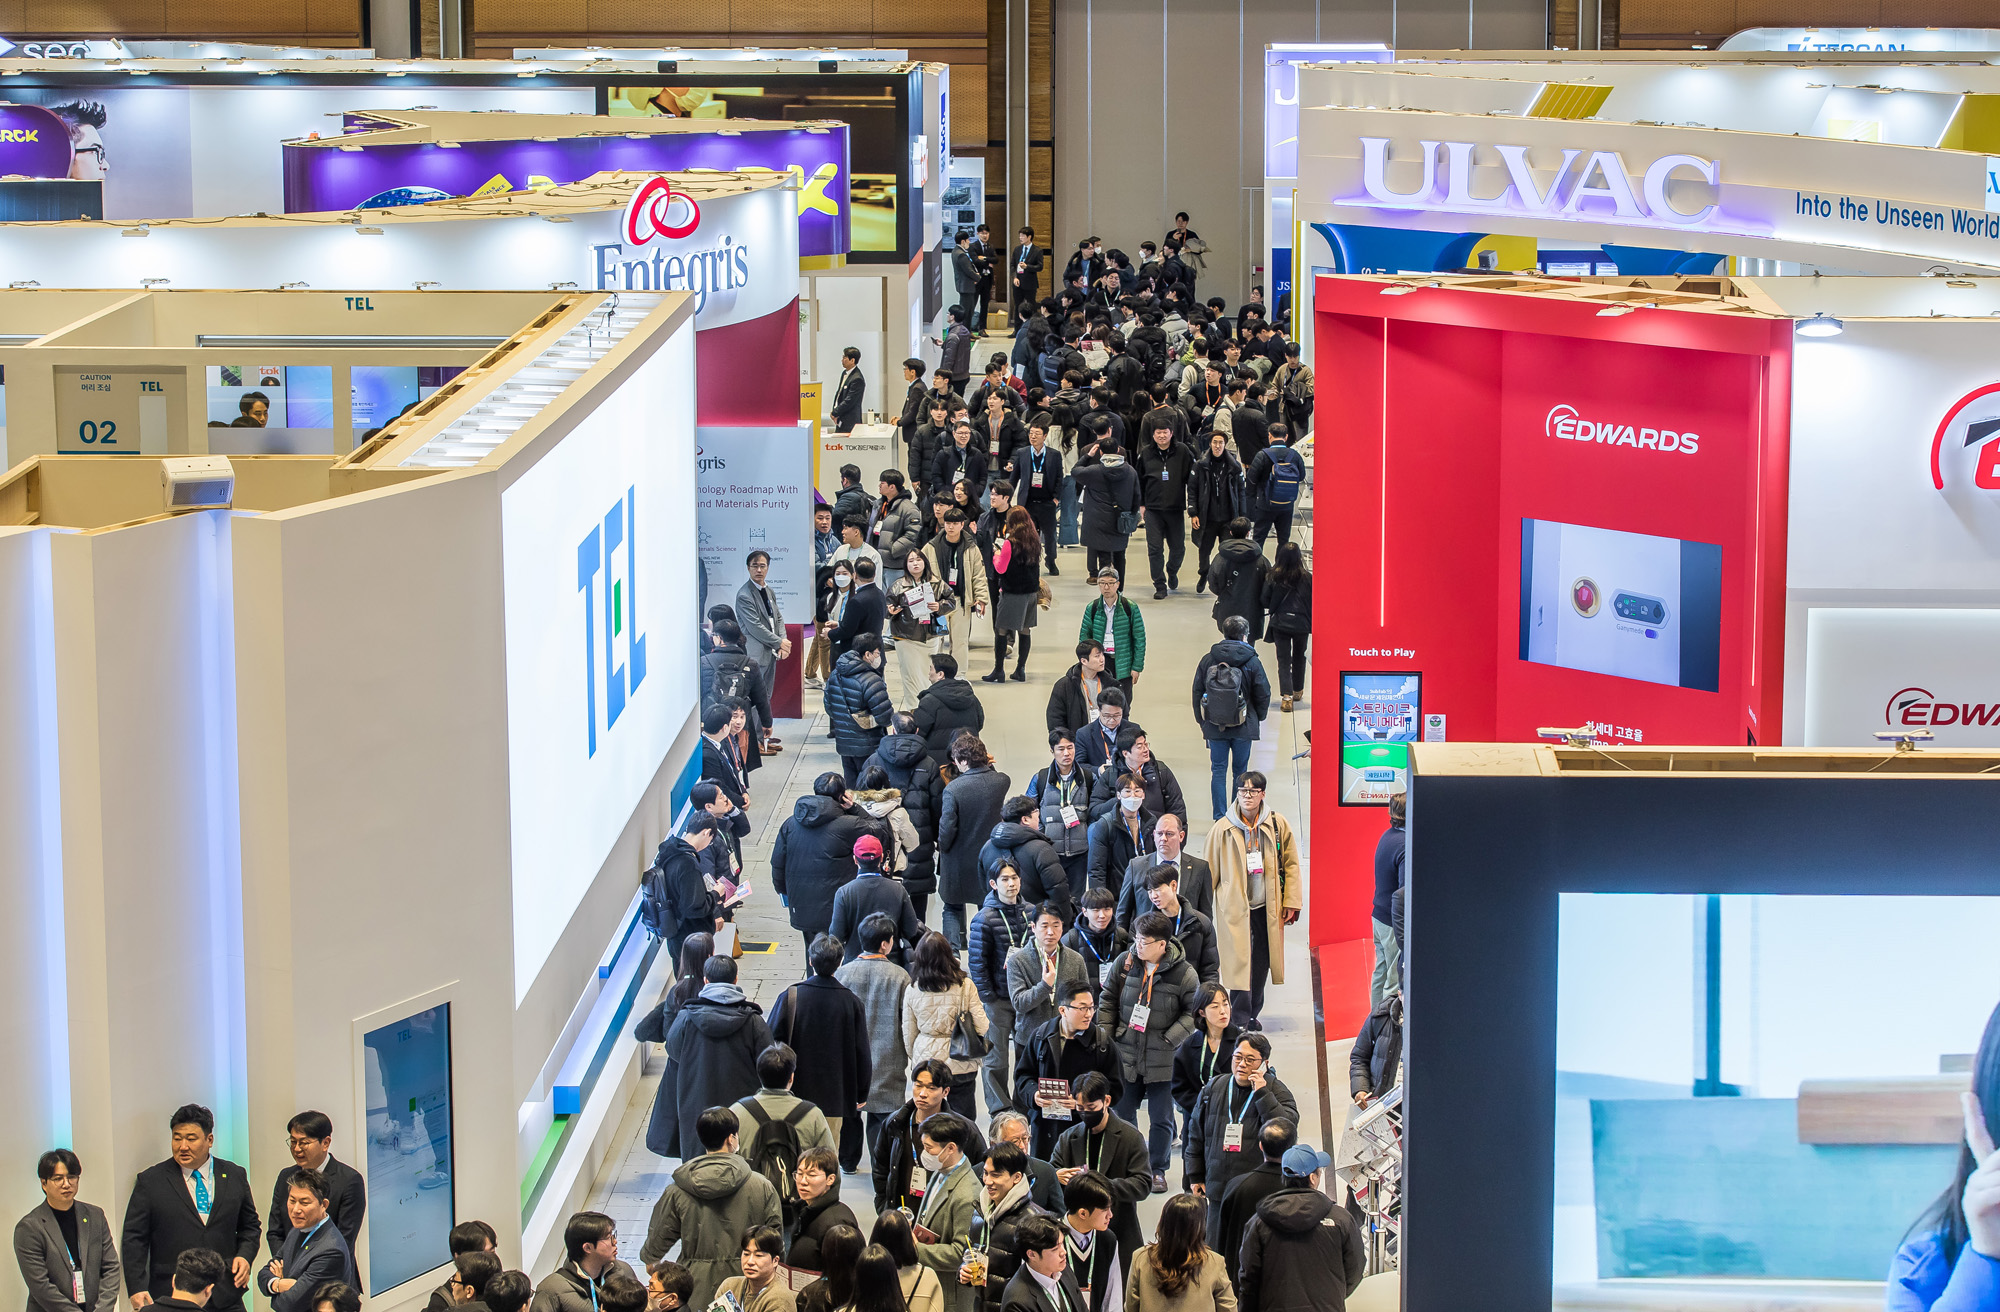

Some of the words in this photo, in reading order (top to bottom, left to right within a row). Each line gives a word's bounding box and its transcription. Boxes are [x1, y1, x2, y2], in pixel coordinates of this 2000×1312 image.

[0, 129, 39, 142] RCK
[1359, 137, 1721, 225] ULVAC
[1796, 191, 1832, 218] Into
[1839, 196, 1869, 221] the
[1876, 200, 1944, 231] Unseen
[1951, 209, 2000, 239] World
[590, 235, 749, 315] Entegris
[1277, 281, 1292, 291] JS
[345, 297, 374, 311] TEL
[259, 366, 280, 375] tok
[81, 383, 95, 392] 머리
[97, 383, 111, 392] 조심
[140, 381, 163, 392] TEL
[79, 420, 117, 444] 02
[1554, 414, 1700, 455] EDWARDS
[825, 443, 844, 451] tok
[697, 456, 726, 474] gris
[730, 484, 774, 496] Roadmap
[777, 484, 799, 494] With
[715, 499, 759, 508] Materials
[762, 499, 790, 511] Purity
[578, 484, 646, 760] TEL
[1616, 623, 1645, 636] Ganymede
[1348, 647, 1379, 657] Touch
[1381, 648, 1392, 657] to
[1393, 648, 1416, 659] Play
[1350, 702, 1411, 714] 스트라이크
[1356, 715, 1406, 728] 가니메데
[1615, 726, 1644, 743] 고효율
[396, 1028, 412, 1043] TEL
